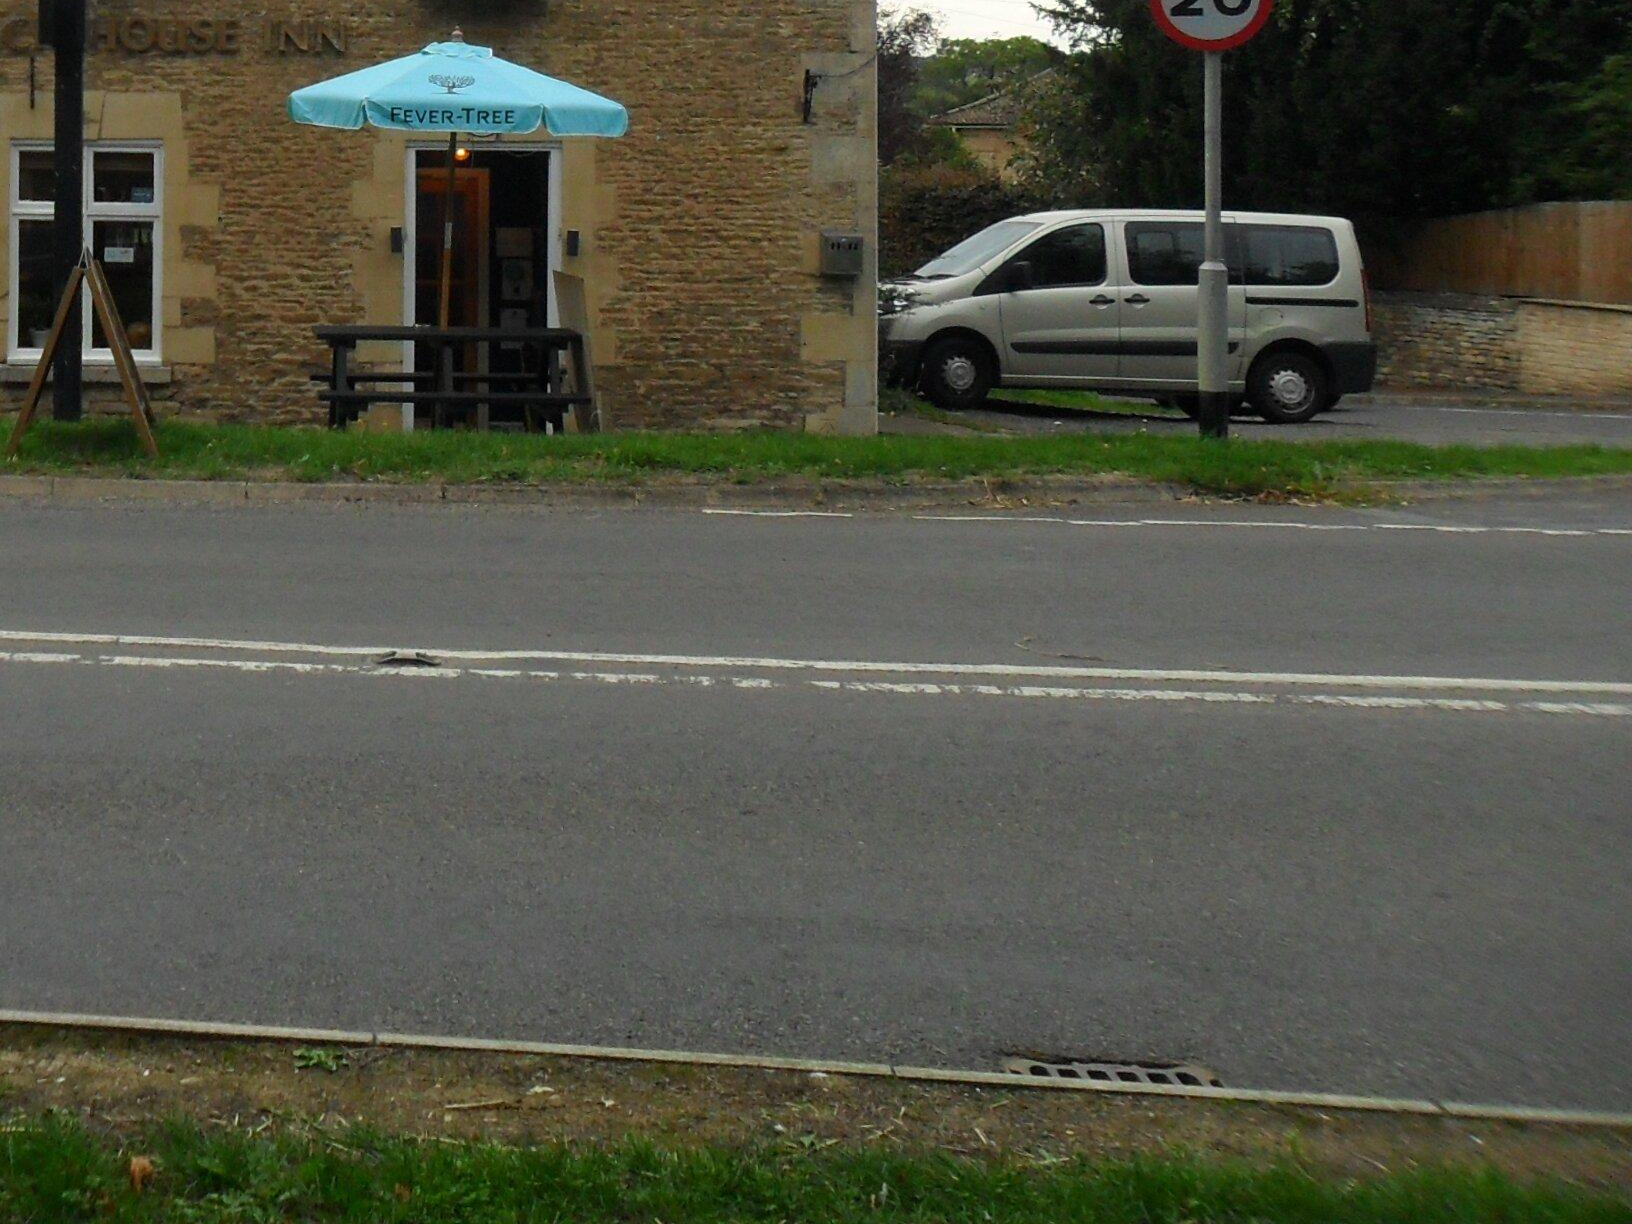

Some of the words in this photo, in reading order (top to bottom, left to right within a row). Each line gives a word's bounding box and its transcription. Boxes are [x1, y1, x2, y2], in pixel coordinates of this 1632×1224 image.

[87, 16, 239, 54] HOUSE
[263, 17, 350, 56] INN
[390, 106, 516, 125] FEVER-TREE
